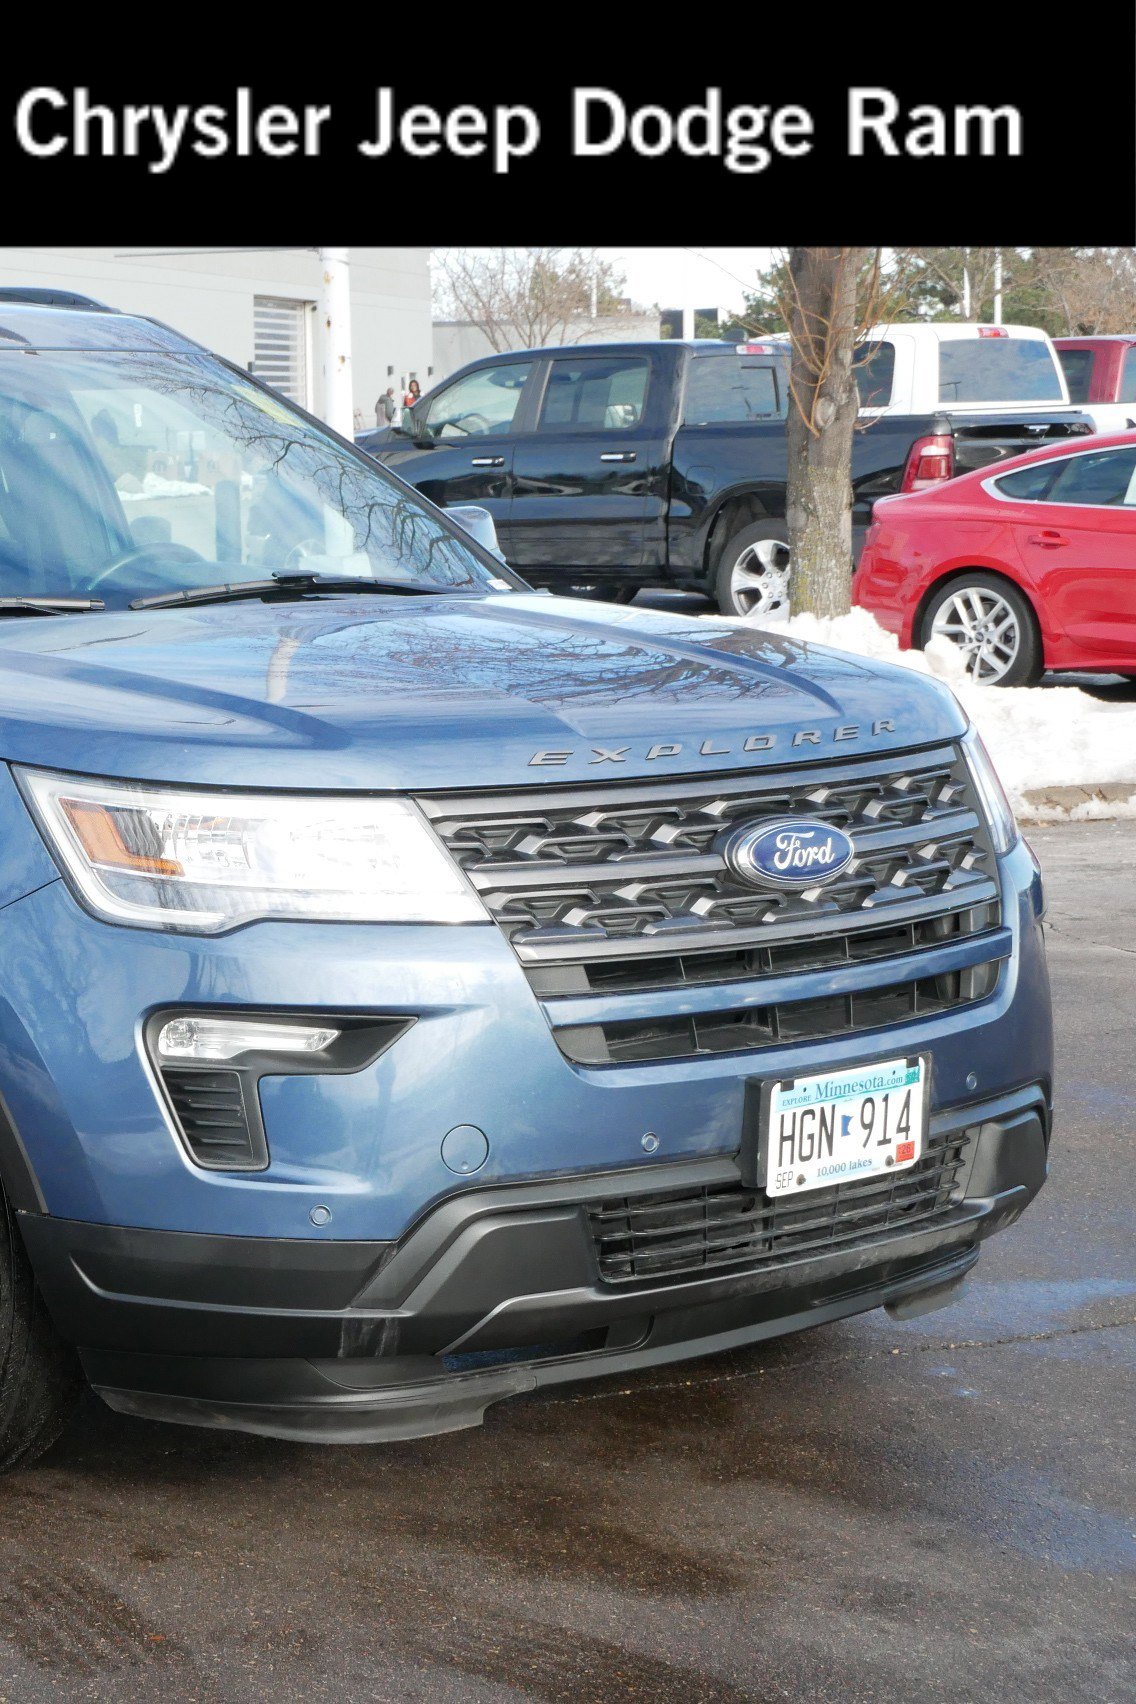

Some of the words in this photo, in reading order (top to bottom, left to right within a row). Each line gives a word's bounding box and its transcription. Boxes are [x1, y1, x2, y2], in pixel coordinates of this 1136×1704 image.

[528, 718, 895, 767] EXPLORER
[773, 830, 835, 870] Ford
[782, 1095, 811, 1106] EXPLORE
[778, 1104, 836, 1167] HGN
[860, 1089, 911, 1148] 914
[775, 1171, 794, 1190] SEP
[817, 1162, 847, 1177] 10,000
[848, 1157, 873, 1171] lakes
